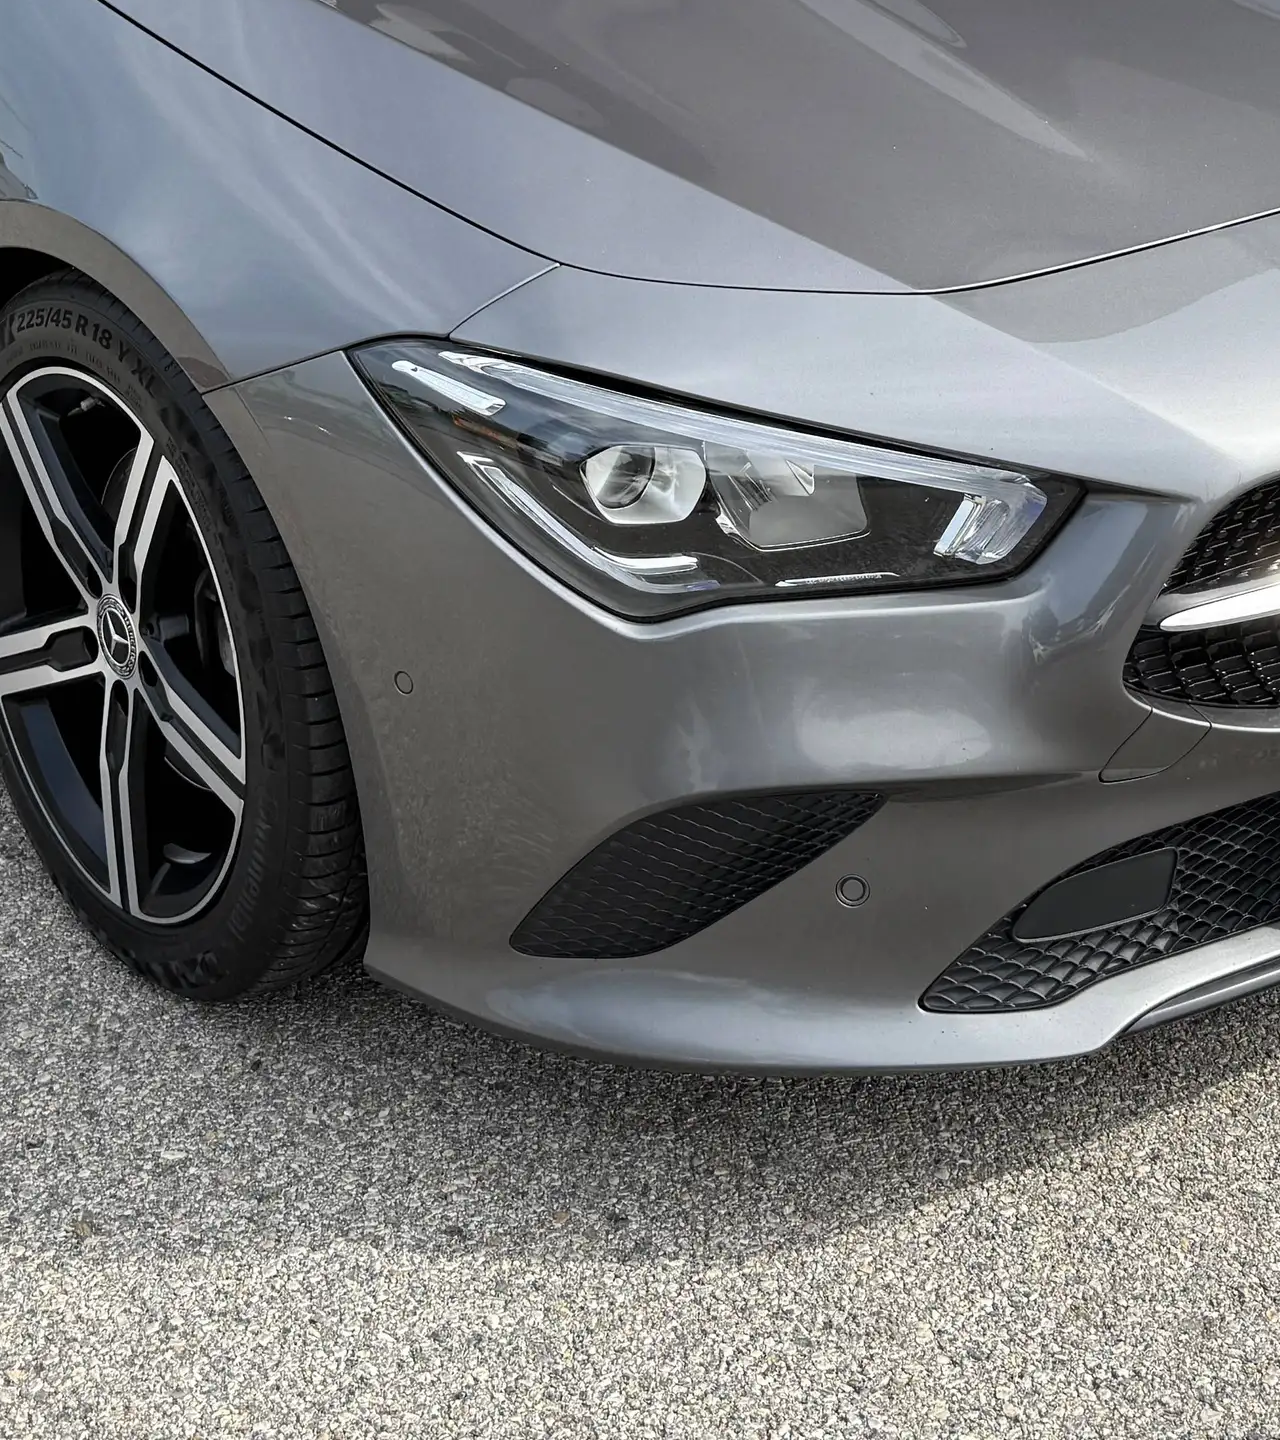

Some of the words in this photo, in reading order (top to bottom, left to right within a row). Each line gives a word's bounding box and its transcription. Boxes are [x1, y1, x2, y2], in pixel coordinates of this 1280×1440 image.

[17, 307, 73, 333] 225/45
[74, 314, 89, 336] R
[92, 323, 112, 350] 18
[118, 340, 130, 363] Y
[131, 356, 157, 399] XL
